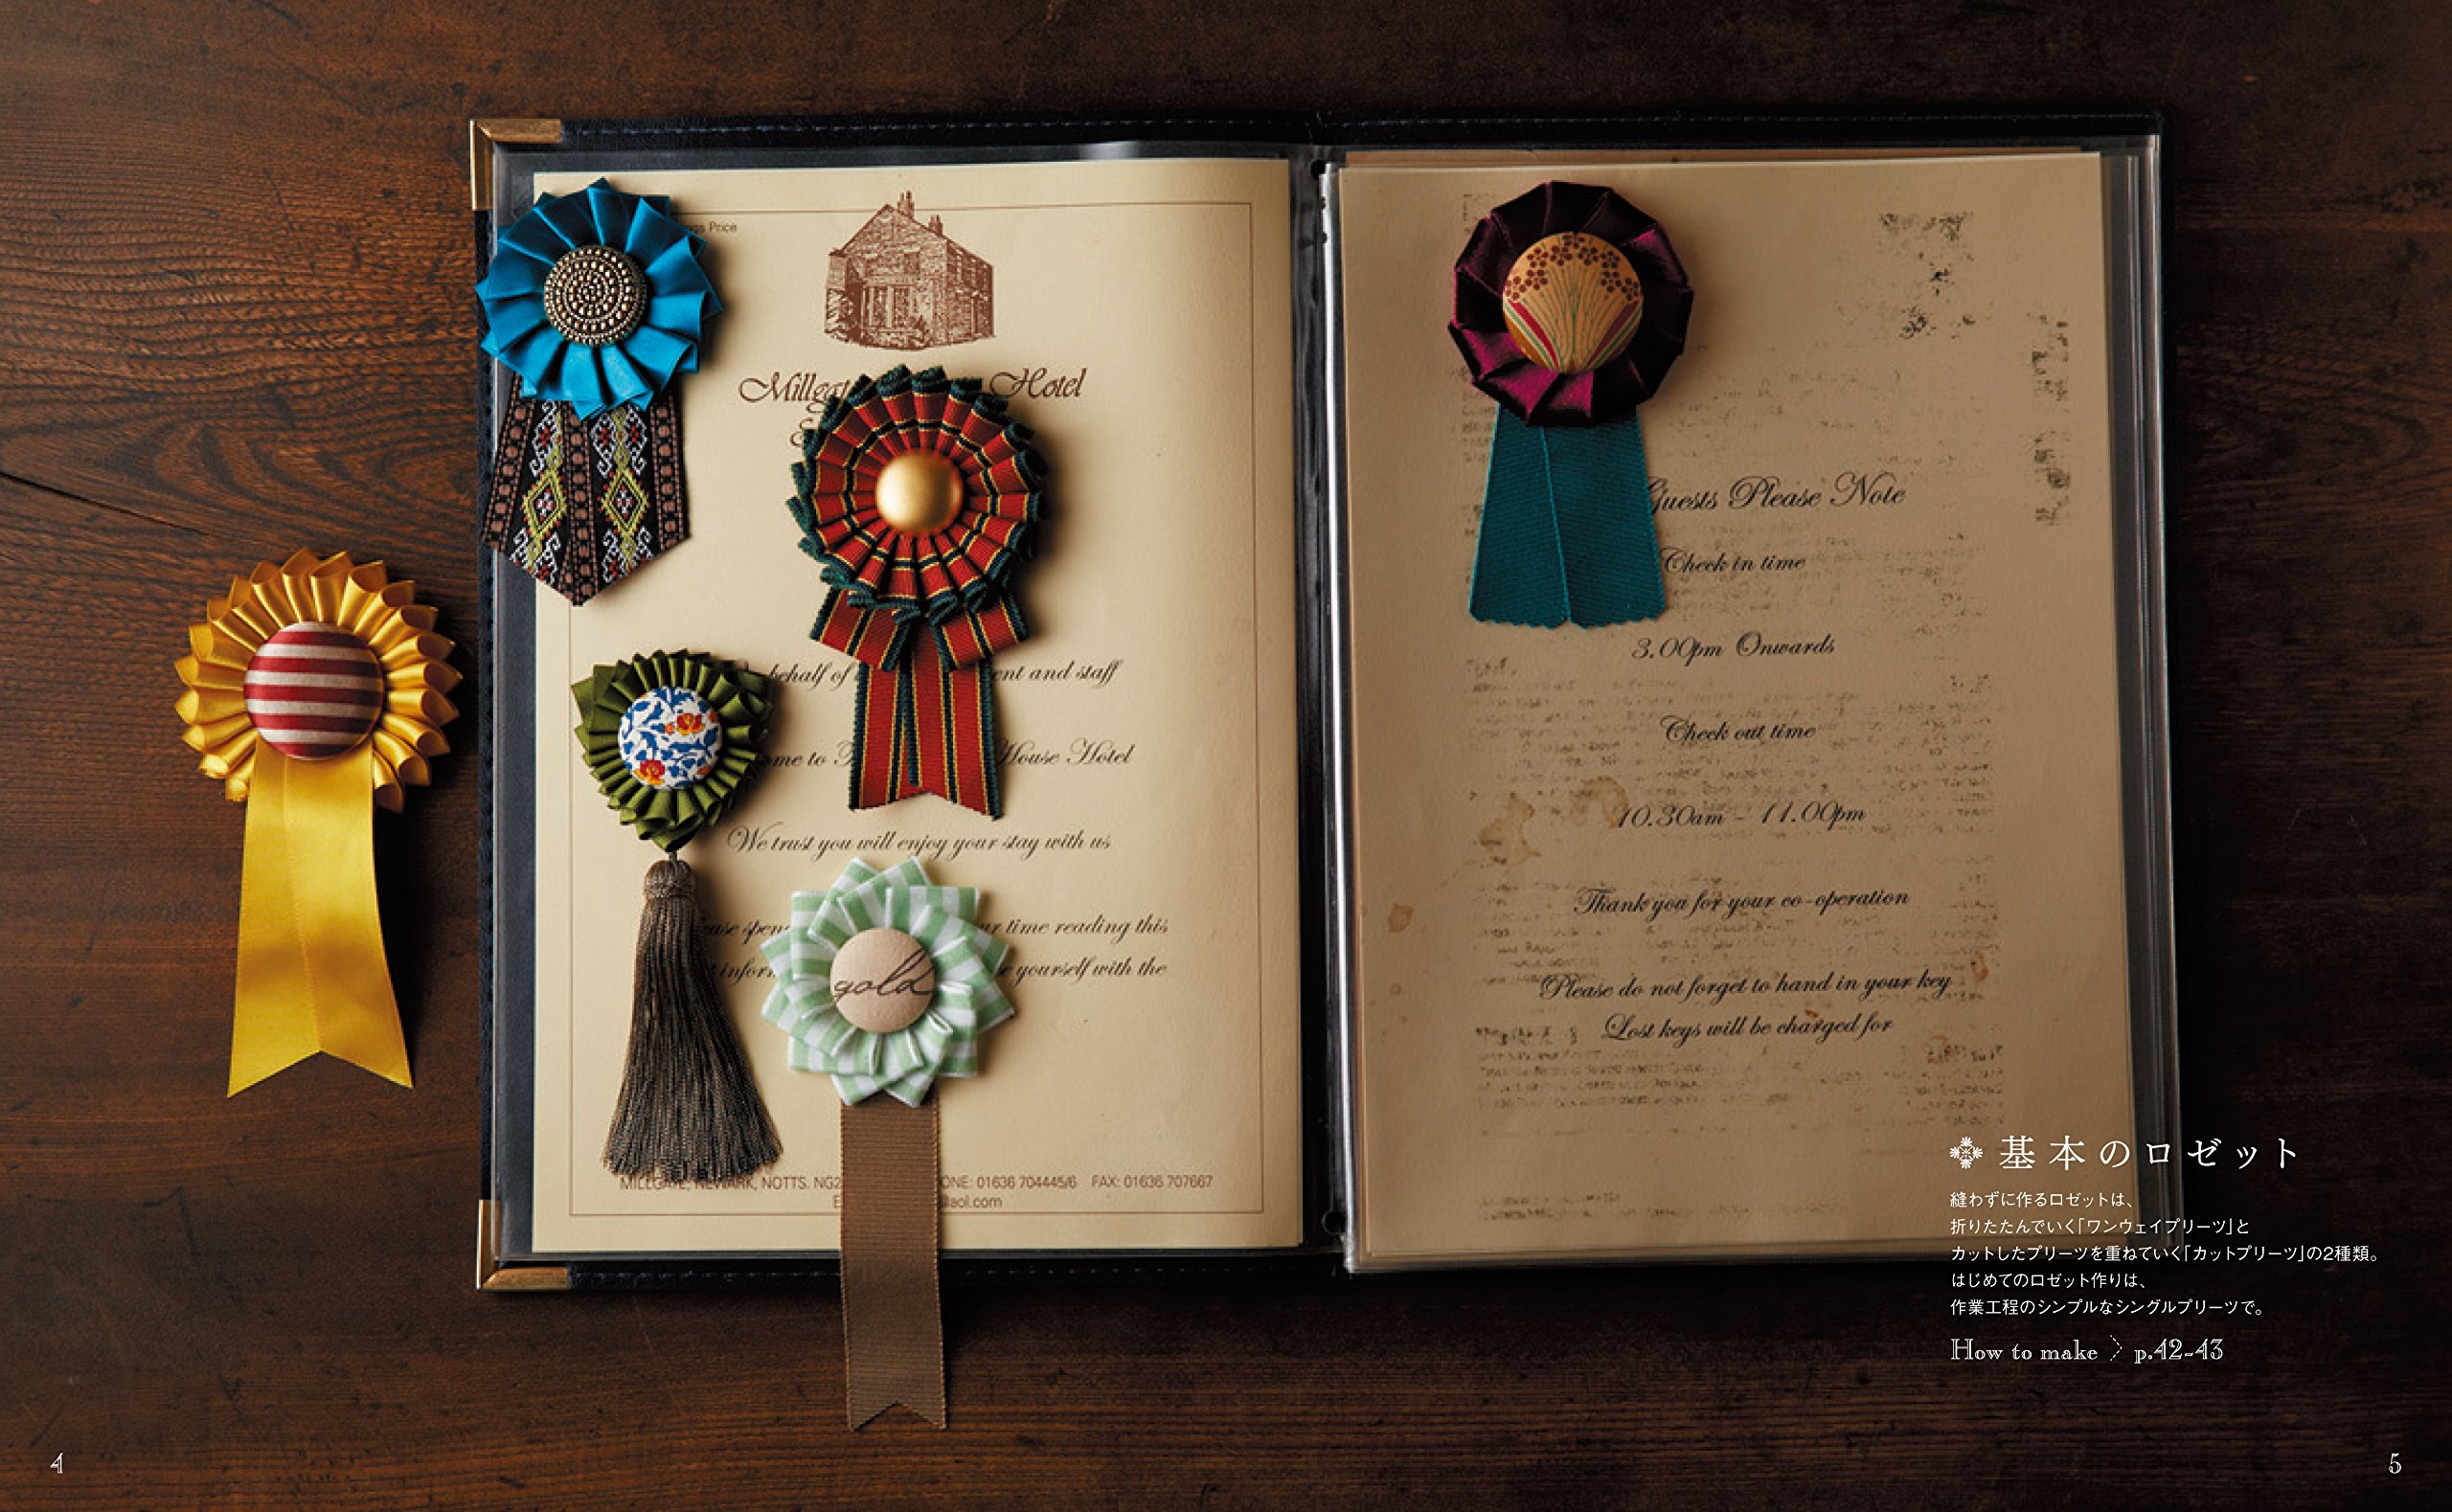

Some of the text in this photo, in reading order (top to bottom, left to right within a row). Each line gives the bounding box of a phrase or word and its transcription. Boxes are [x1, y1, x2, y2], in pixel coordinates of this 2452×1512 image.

[738, 367, 1087, 414] Millgat Hotel
[1646, 470, 1906, 515] Guests Please Note
[1659, 545, 1806, 574] Check in time
[1631, 631, 1836, 667] 3.00pm Onwards
[768, 663, 832, 690] behalf
[829, 661, 857, 690] of
[1028, 659, 1077, 681] and
[1075, 658, 1125, 688] staff
[1660, 714, 1817, 743] Check out time
[807, 752, 828, 766] to
[994, 738, 1060, 765] House
[1066, 737, 1135, 765] Hotel
[1614, 803, 1725, 828] 10.30am
[1761, 801, 1865, 831] 11.00pm
[728, 821, 1112, 863] We trust you will enjoy your stay with us
[1574, 888, 1646, 914] Thank
[1645, 898, 1689, 923] you
[1682, 889, 1724, 920] for
[1722, 896, 1775, 921] your
[741, 919, 791, 946] spen
[1005, 918, 1050, 935] time
[1054, 914, 1131, 945] reading
[1134, 914, 1169, 934] this
[832, 948, 937, 1004] gold
[1011, 957, 1097, 989] yourself
[1091, 957, 1132, 976] with
[1136, 957, 1169, 976] the
[1539, 968, 1954, 1005] Please do not forget to hand in your key
[1601, 1013, 1655, 1041] Lost
[1657, 1018, 1702, 1049] keys
[1706, 1015, 1749, 1036] will
[1749, 1015, 1772, 1035] be
[1776, 1012, 1864, 1044] charged
[1853, 1011, 1893, 1042] for
[814, 1176, 842, 1190] NG2
[977, 1174, 1015, 1190] 01636
[1091, 1174, 1122, 1188] FAX:
[1124, 1174, 1164, 1188] 01636
